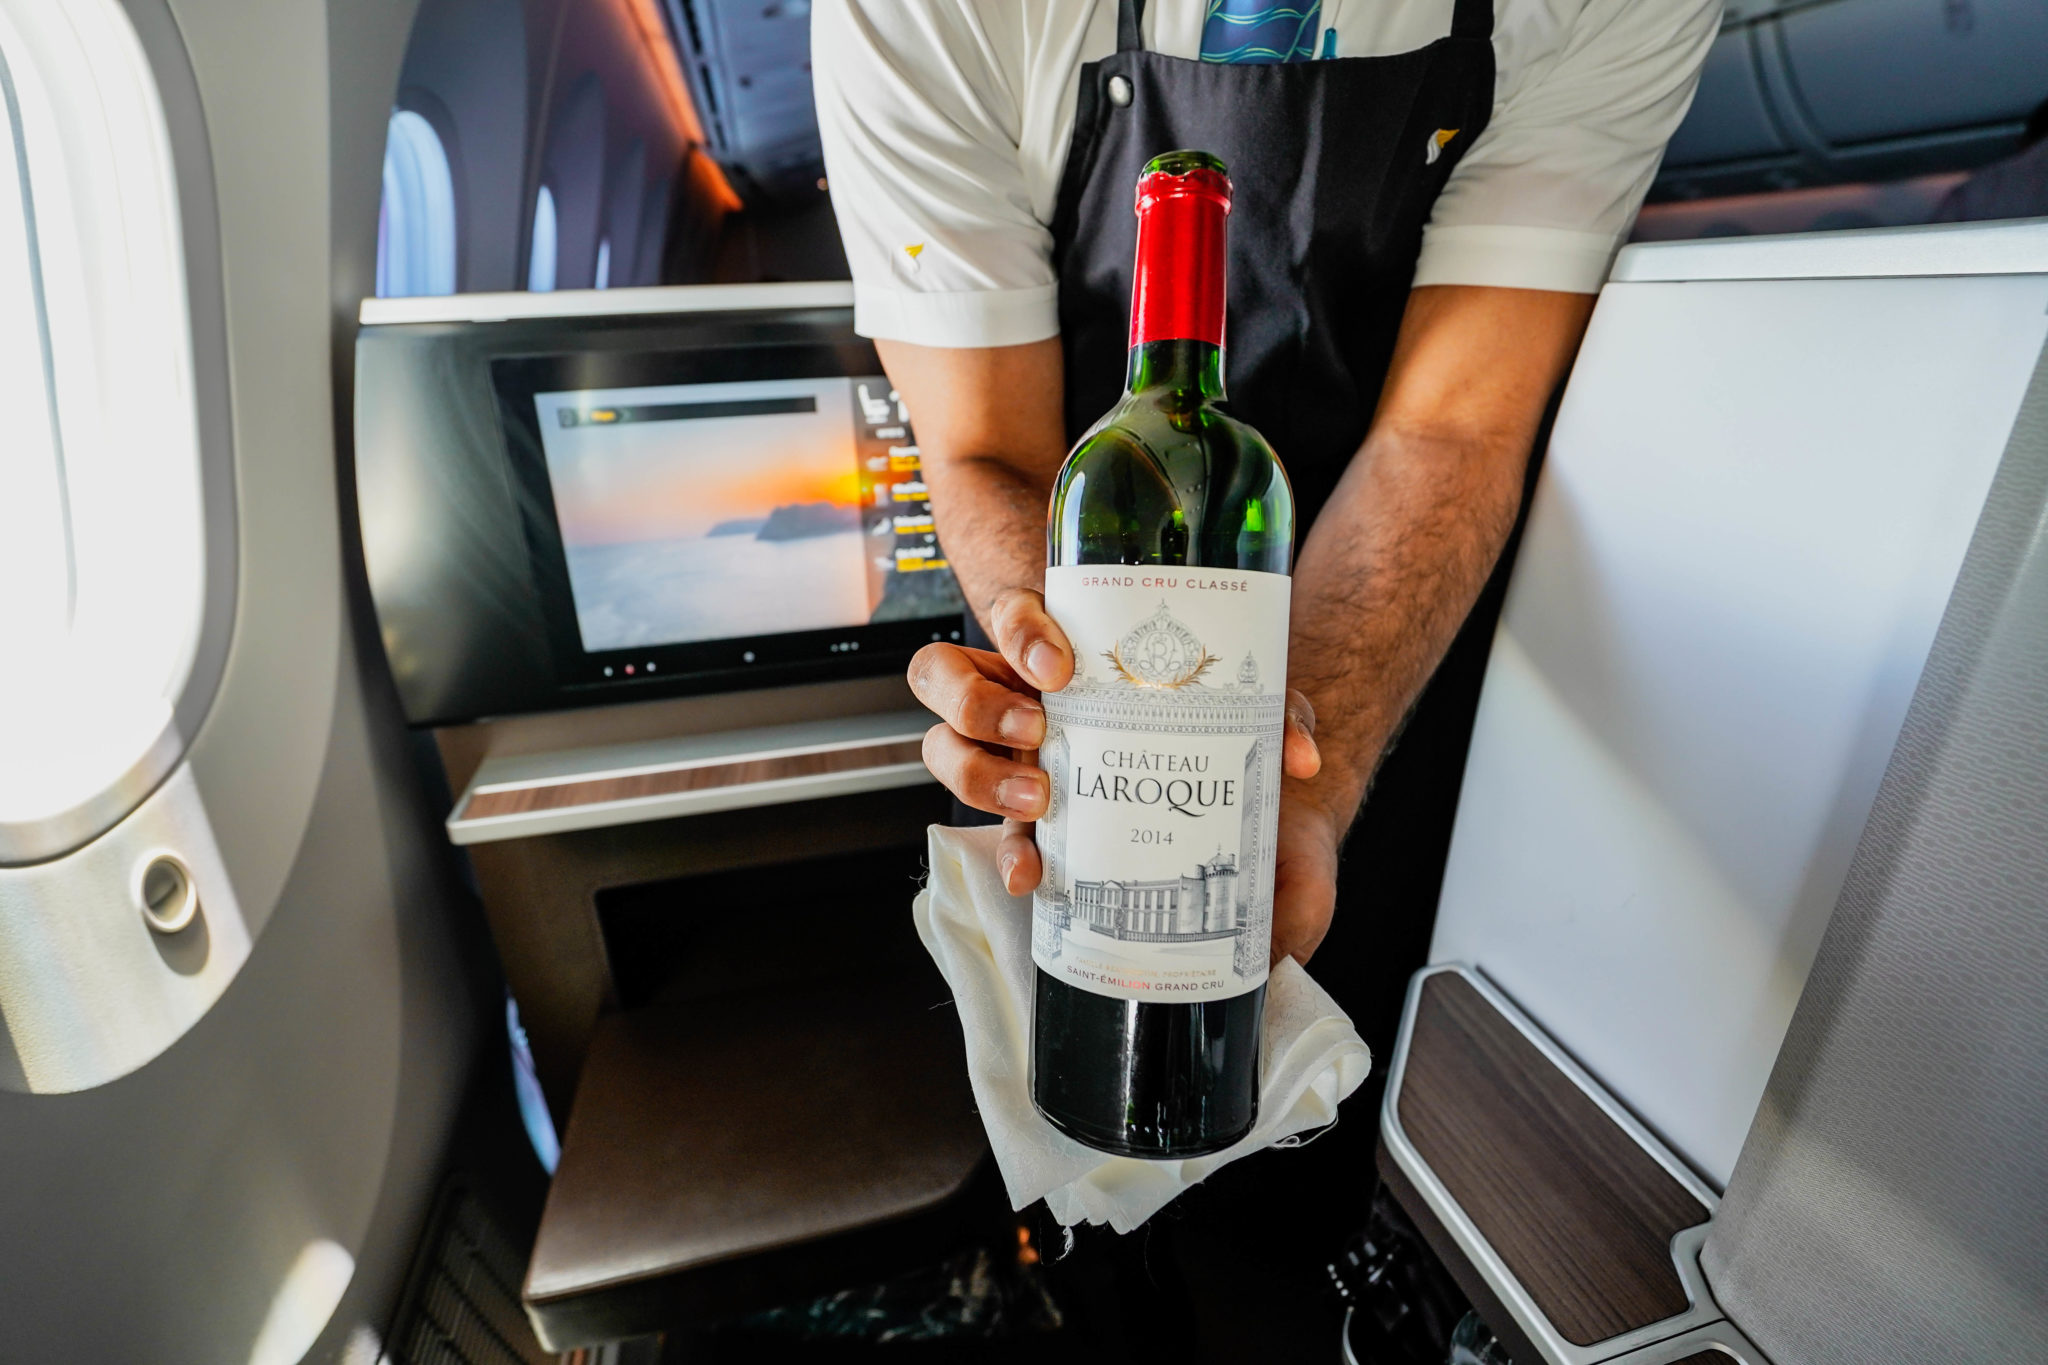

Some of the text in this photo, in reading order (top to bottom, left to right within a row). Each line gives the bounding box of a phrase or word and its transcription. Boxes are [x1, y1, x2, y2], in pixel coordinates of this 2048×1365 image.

[1082, 577, 1248, 592] GRAND CRU CLASSÉ
[1102, 749, 1209, 773] CHÂTEAU
[1077, 766, 1235, 818] LAROQUE
[1130, 829, 1174, 845] 2014
[1067, 965, 1150, 990] SAINT-ÉMILION
[1155, 982, 1198, 991] GRAND
[1202, 980, 1225, 990] CRU
